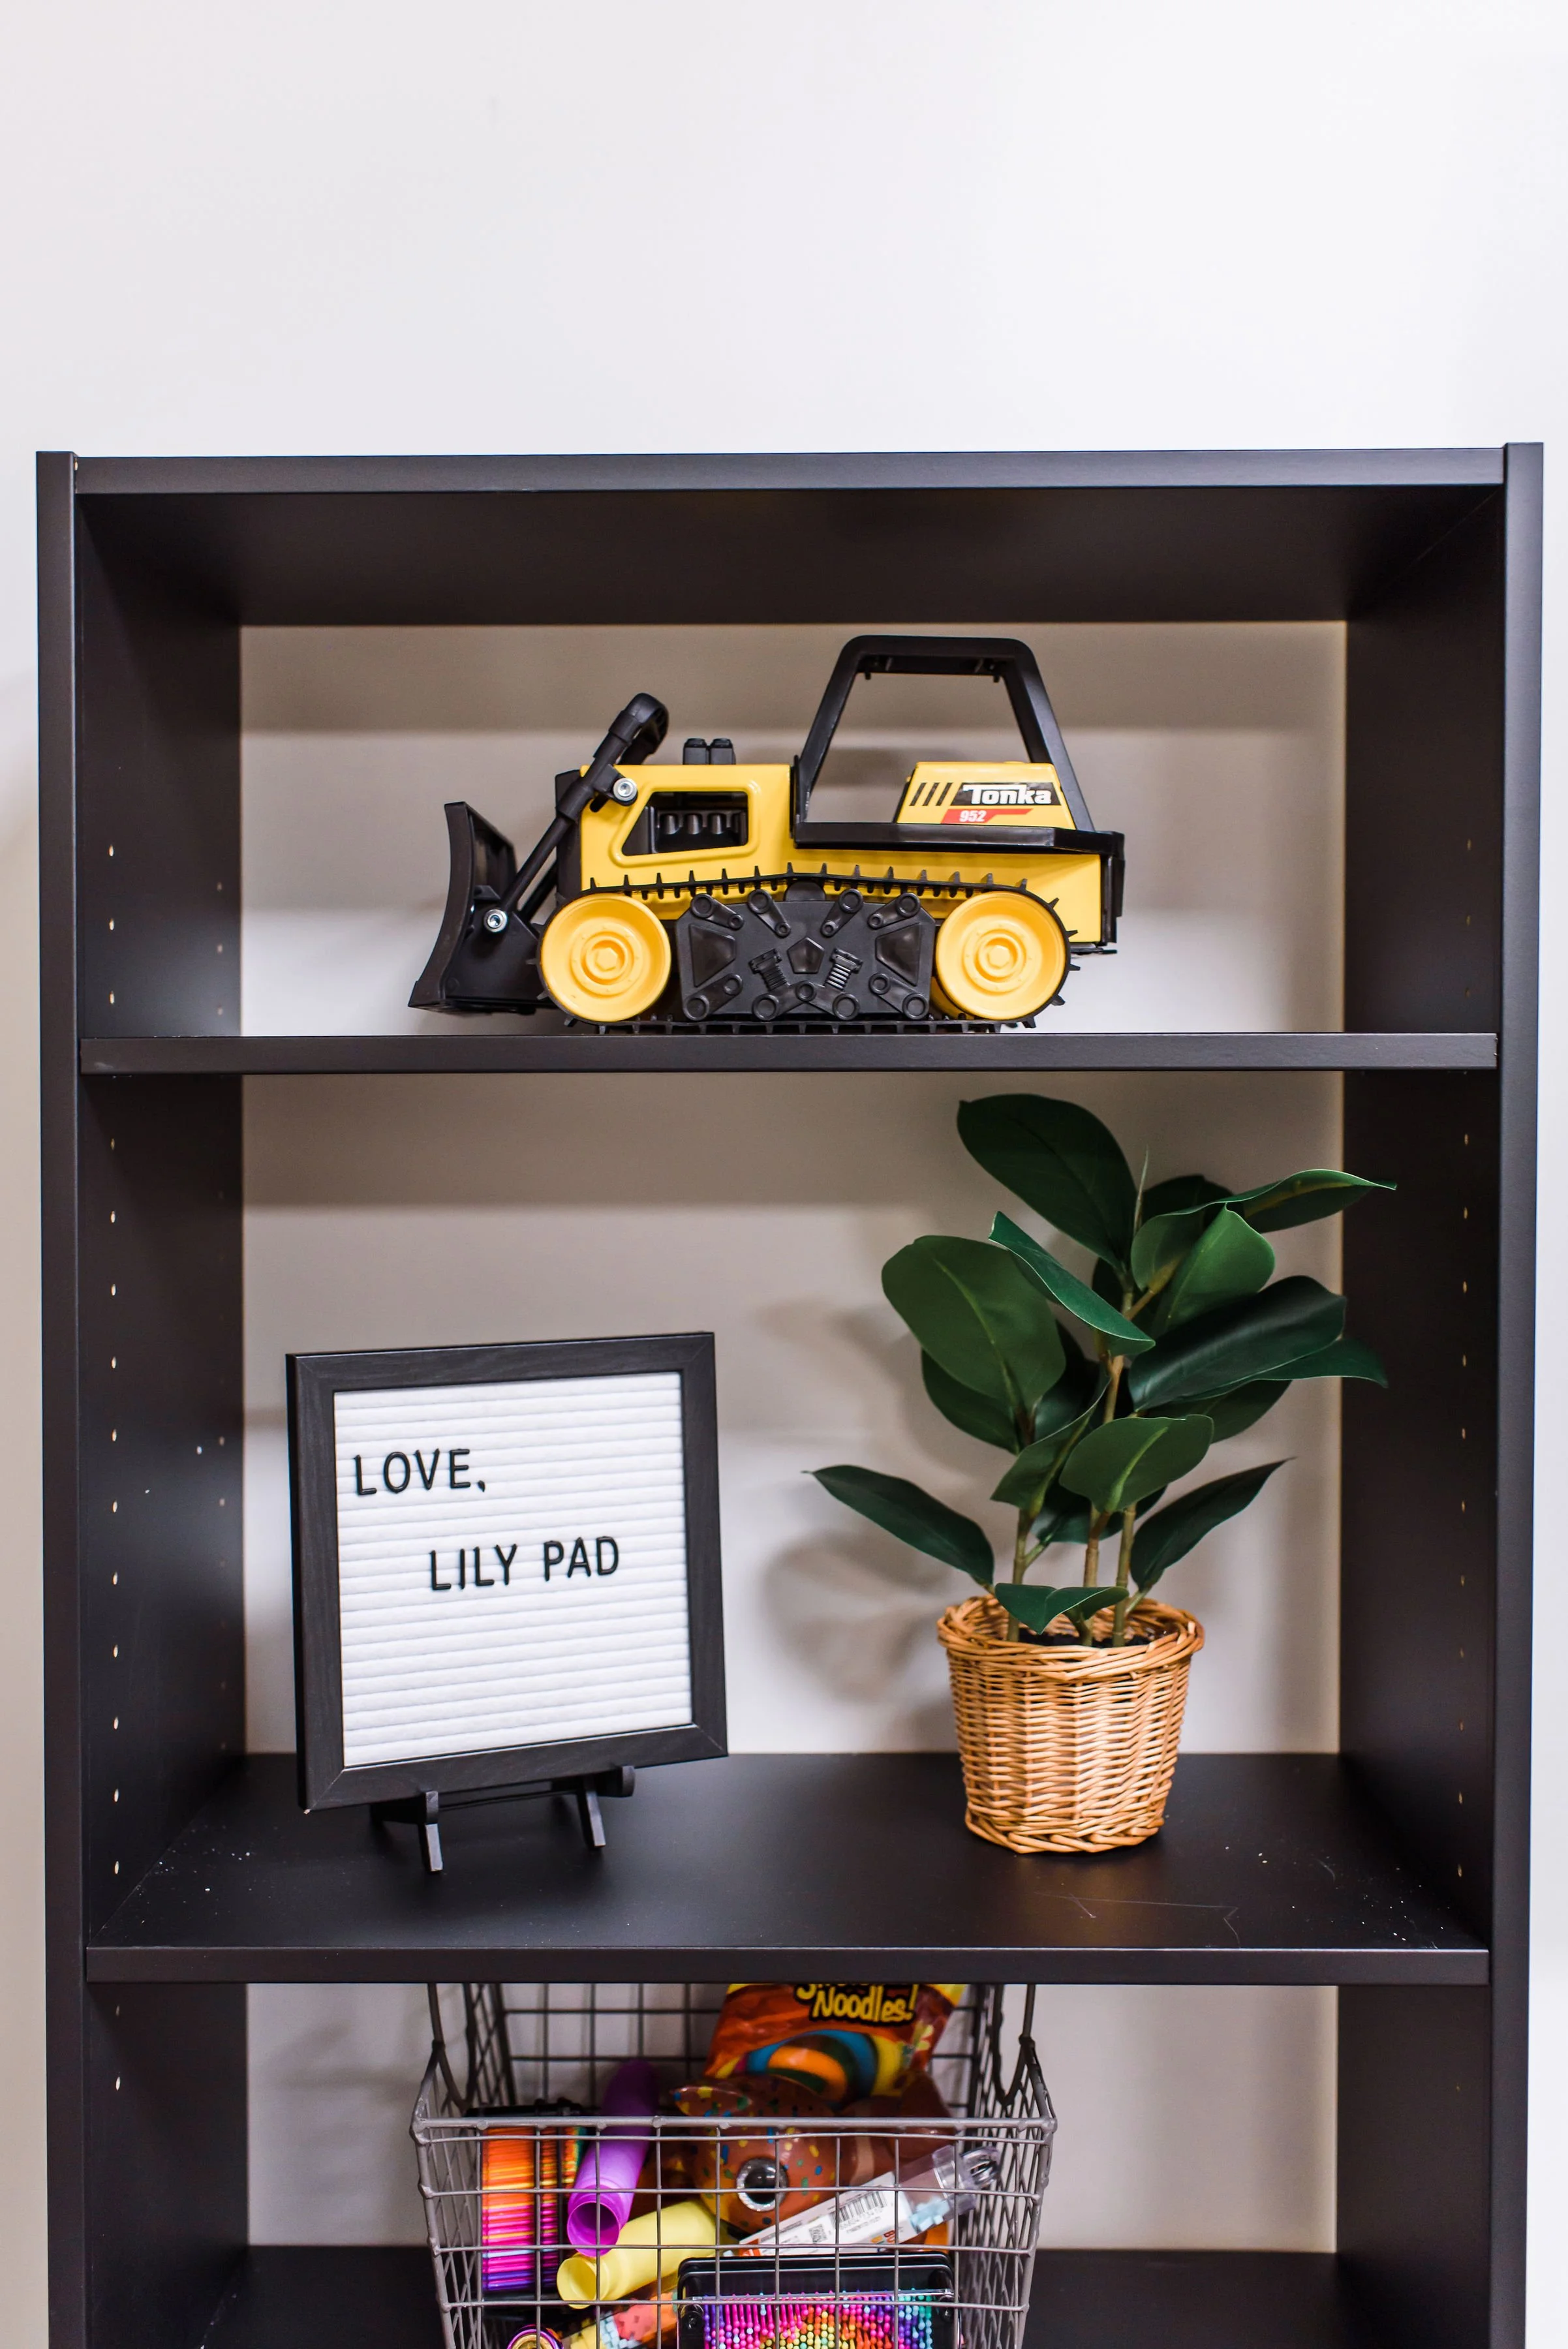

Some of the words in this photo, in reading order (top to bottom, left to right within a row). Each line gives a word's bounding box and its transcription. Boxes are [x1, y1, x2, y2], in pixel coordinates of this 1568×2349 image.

[962, 784, 1052, 805] Tonka
[959, 810, 987, 823] 952
[353, 1448, 486, 1496] LOVE,
[429, 1544, 517, 1591] LILY
[543, 1535, 619, 1582] PAD
[812, 1984, 919, 2023] Noodles!
